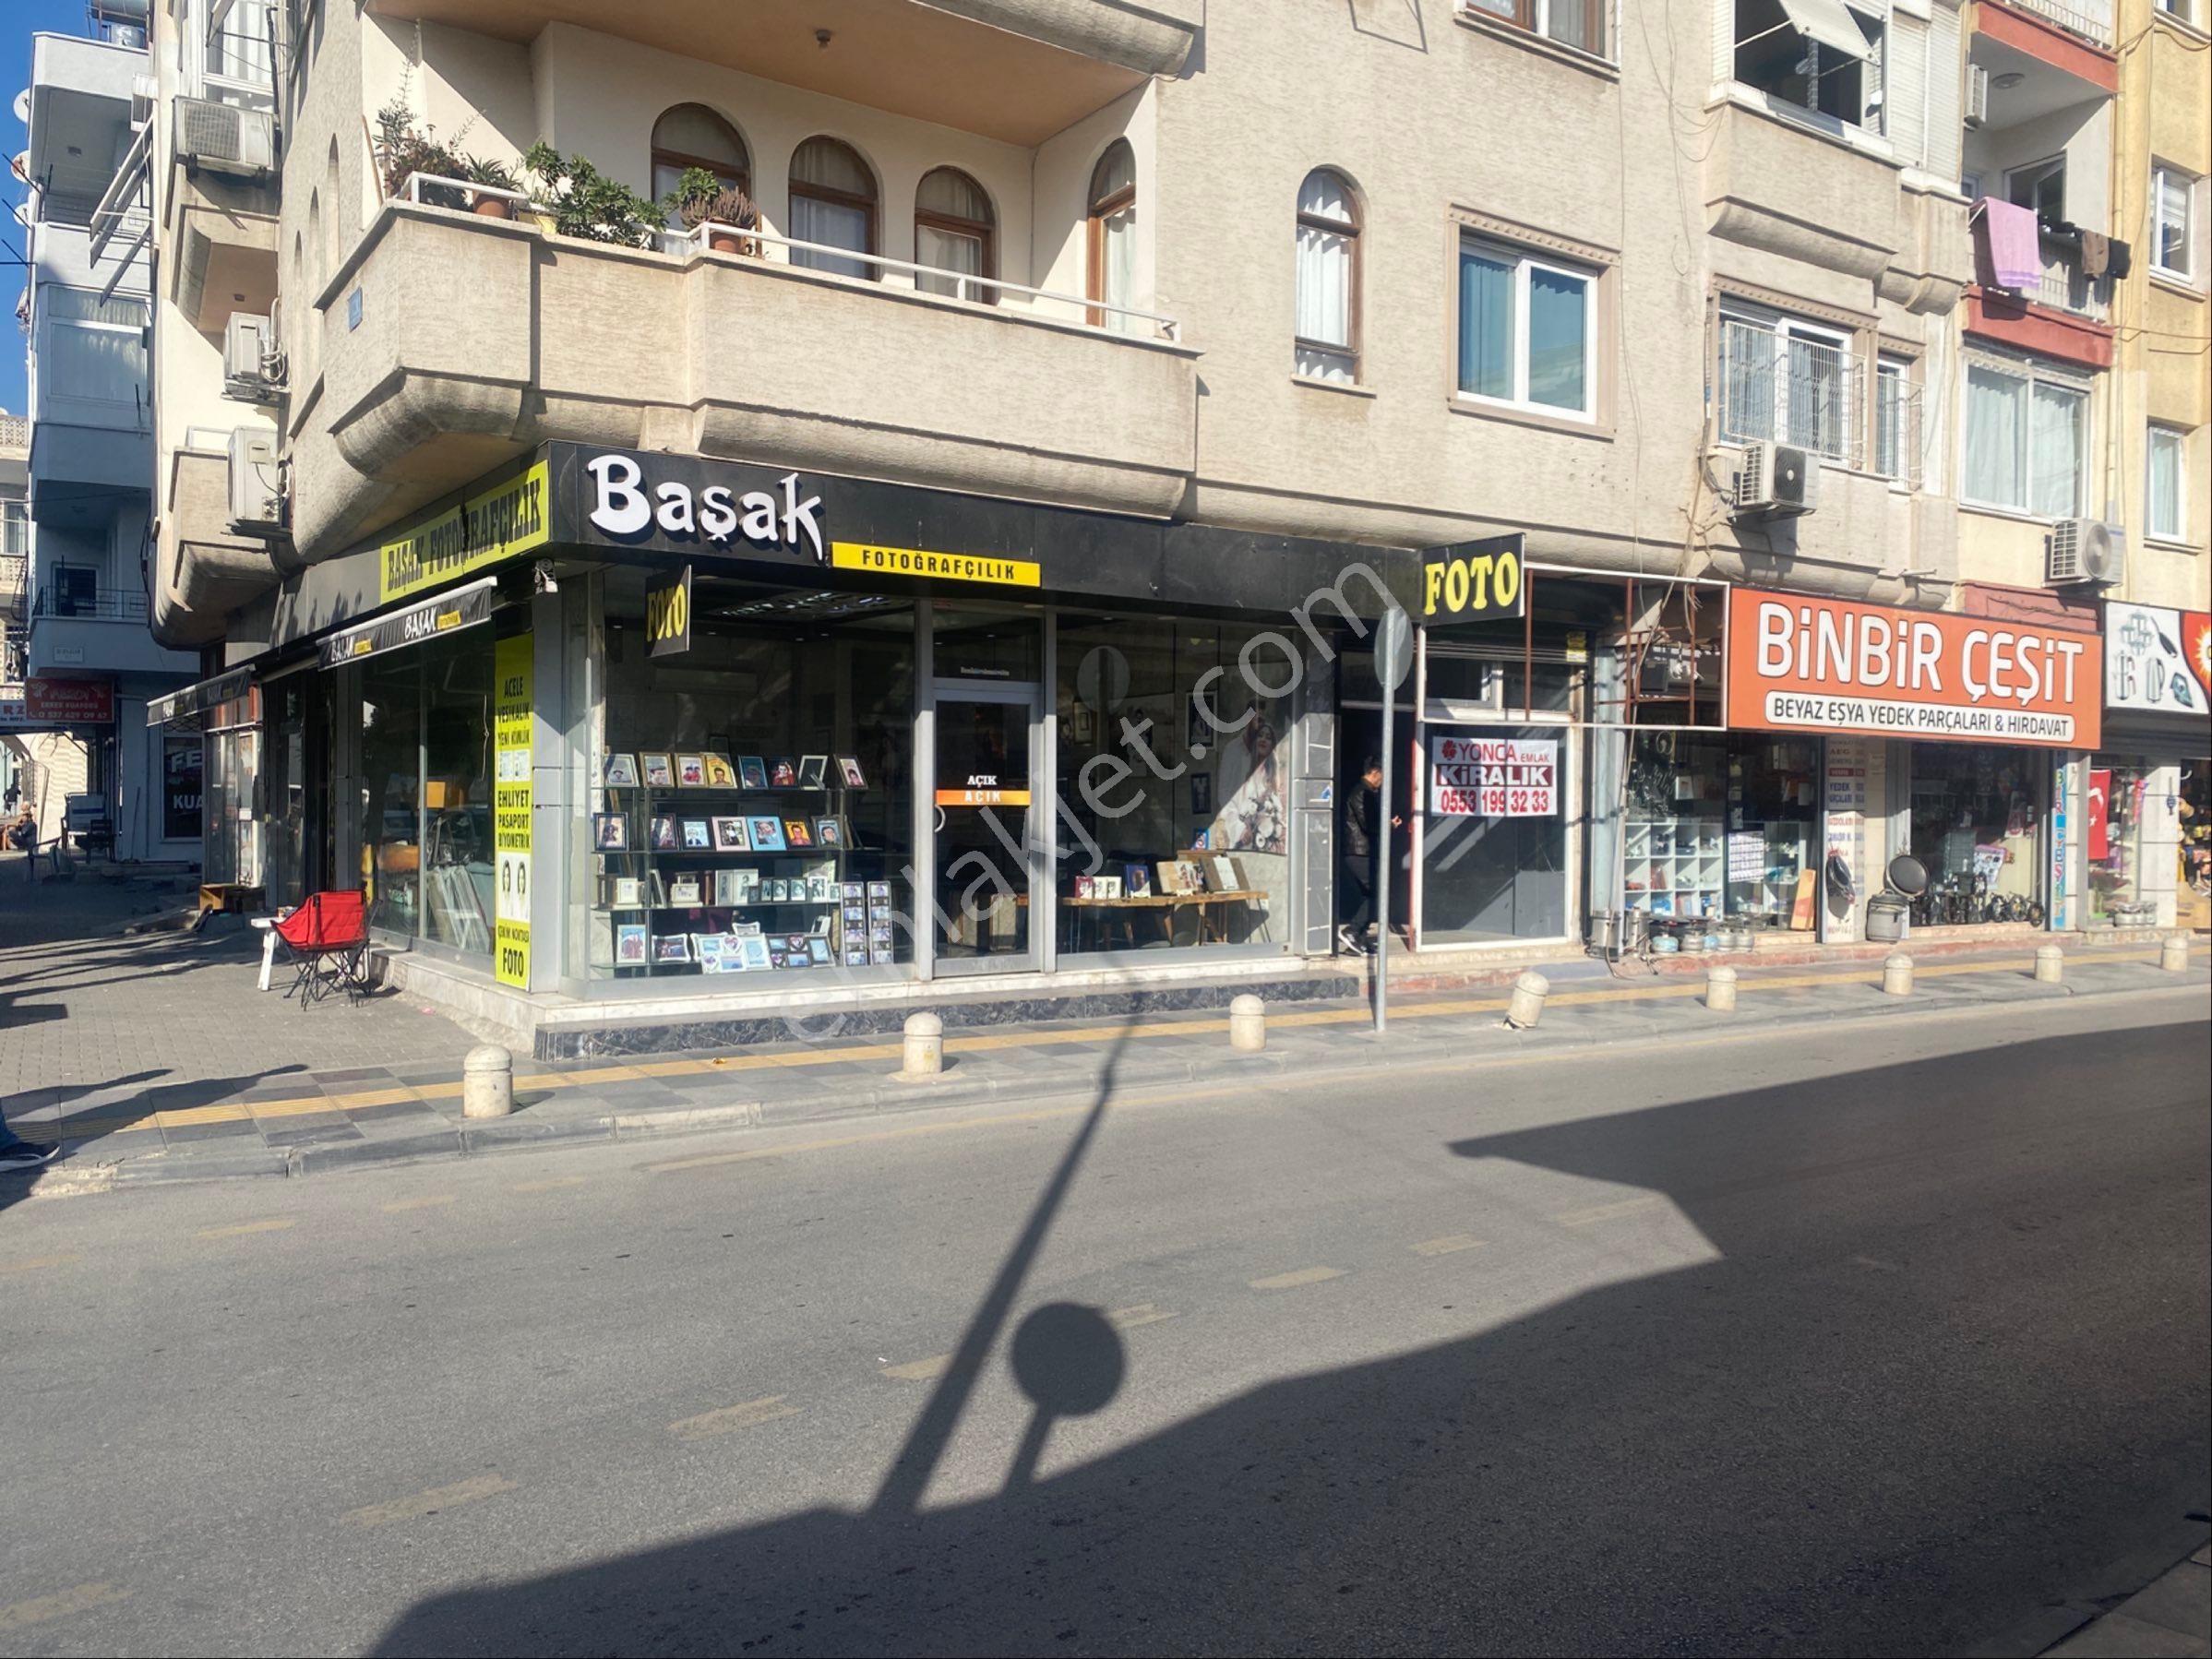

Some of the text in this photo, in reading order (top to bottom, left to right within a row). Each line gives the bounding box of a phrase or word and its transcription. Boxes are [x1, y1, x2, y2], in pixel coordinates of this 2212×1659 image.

[587, 454, 823, 560] Başak
[862, 548, 1016, 580] FOTOĞRAFÇILIK
[1424, 551, 1519, 615] FOTO
[647, 583, 685, 642] FOTO
[504, 676, 523, 698] ACELE
[1774, 698, 2069, 736] BEYAZ EŞYA YEDEK PARÇALARI & HIRDAVAT
[1458, 743, 1549, 763] YONCA EMLAK
[967, 775, 997, 787] AÇIK
[498, 787, 530, 808] EHLİYET
[964, 791, 1001, 805] AÇIK
[1441, 790, 1548, 813] 0553 199 32 33
[498, 813, 529, 830] PASAPORT
[503, 948, 524, 978] FOTO
